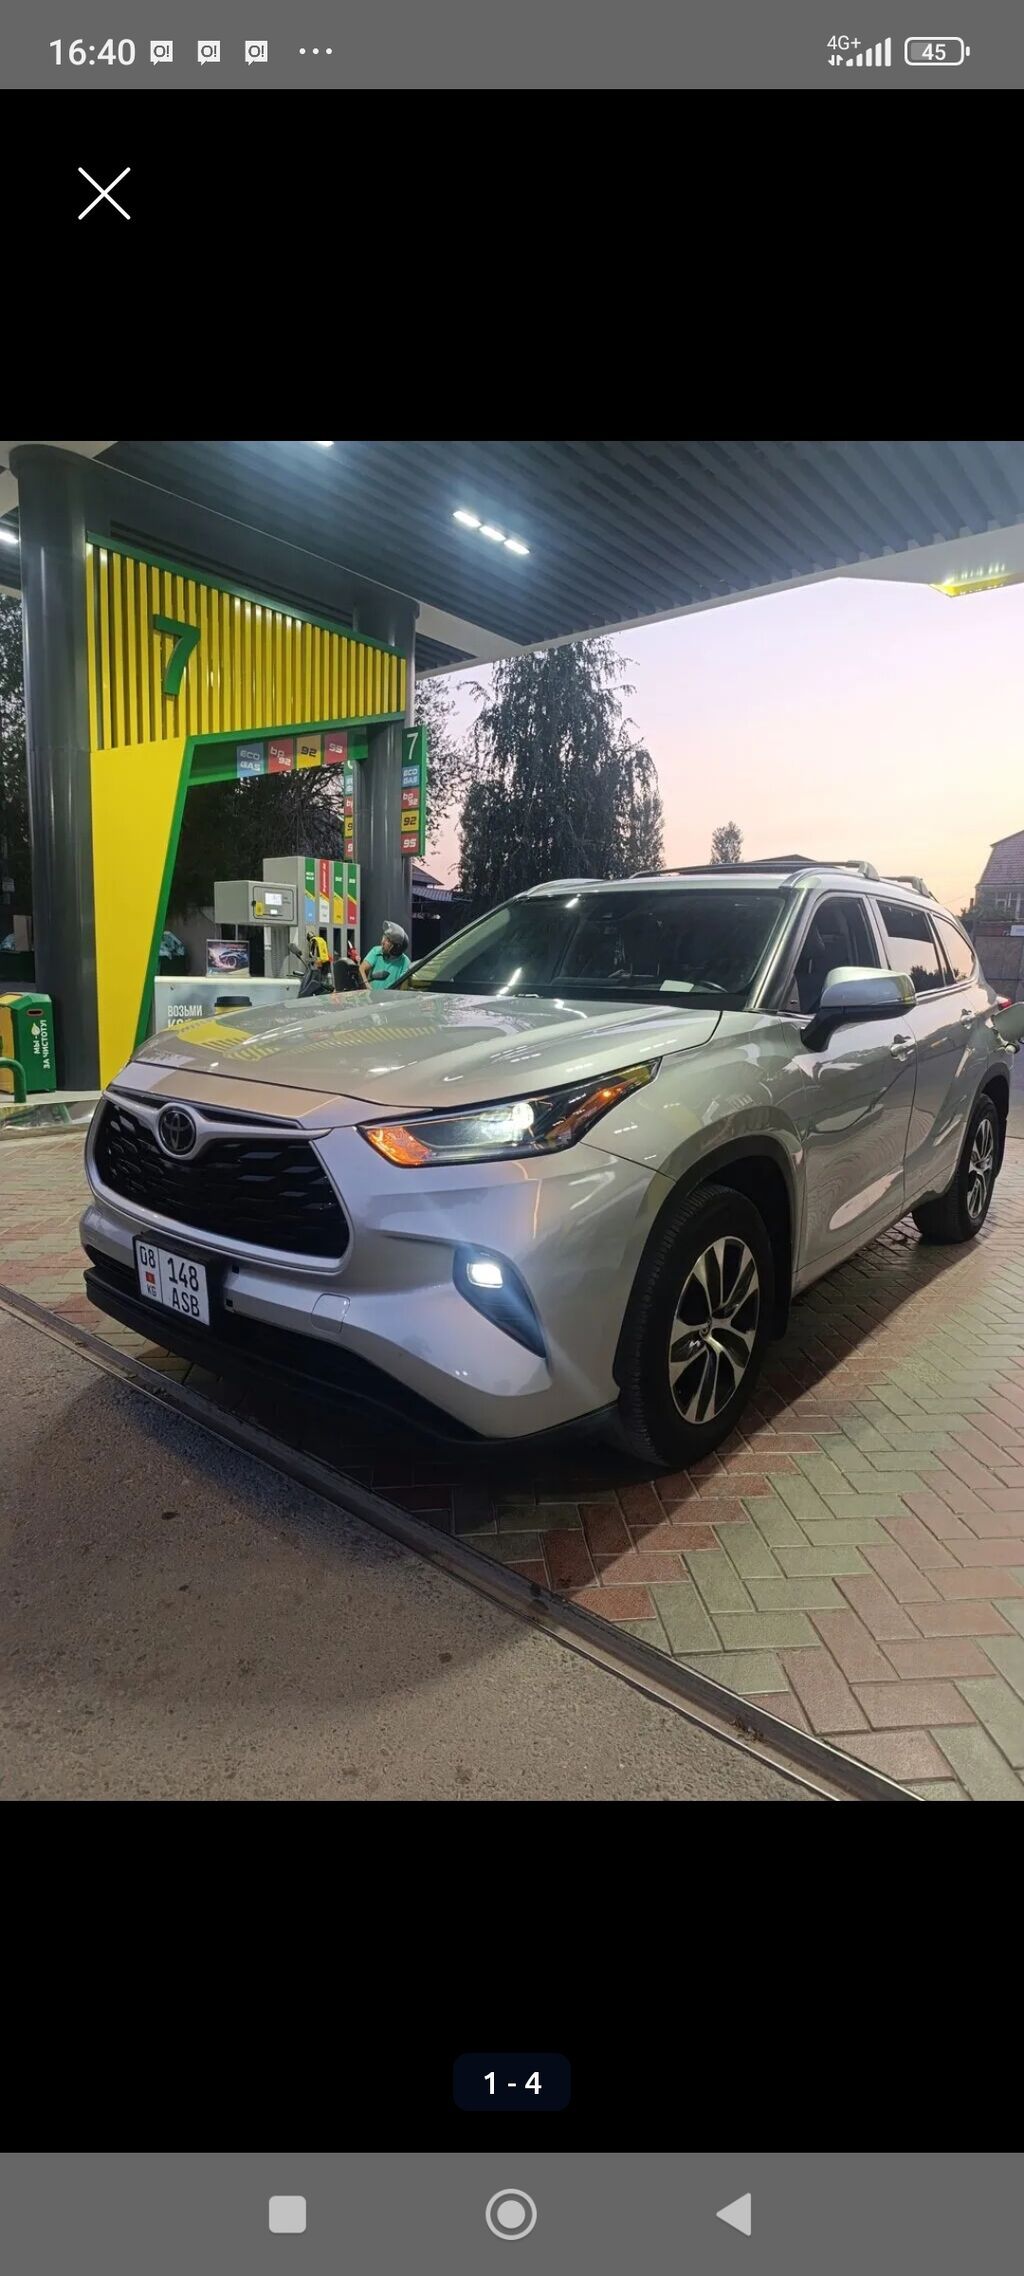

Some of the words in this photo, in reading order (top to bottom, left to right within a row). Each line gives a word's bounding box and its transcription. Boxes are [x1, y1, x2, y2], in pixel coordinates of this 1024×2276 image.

[153, 614, 201, 696] 7
[301, 746, 317, 758] 92
[406, 732, 419, 760] 7
[403, 816, 417, 826] 92
[403, 838, 417, 848] 95
[167, 1004, 203, 1017] ВОЗЬМИ
[33, 1040, 40, 1054] МЫ
[43, 1058, 51, 1069] ЗА
[140, 1245, 156, 1268] 08
[167, 1257, 199, 1292] 148
[146, 1283, 157, 1297] KG
[172, 1287, 200, 1318] ASB
